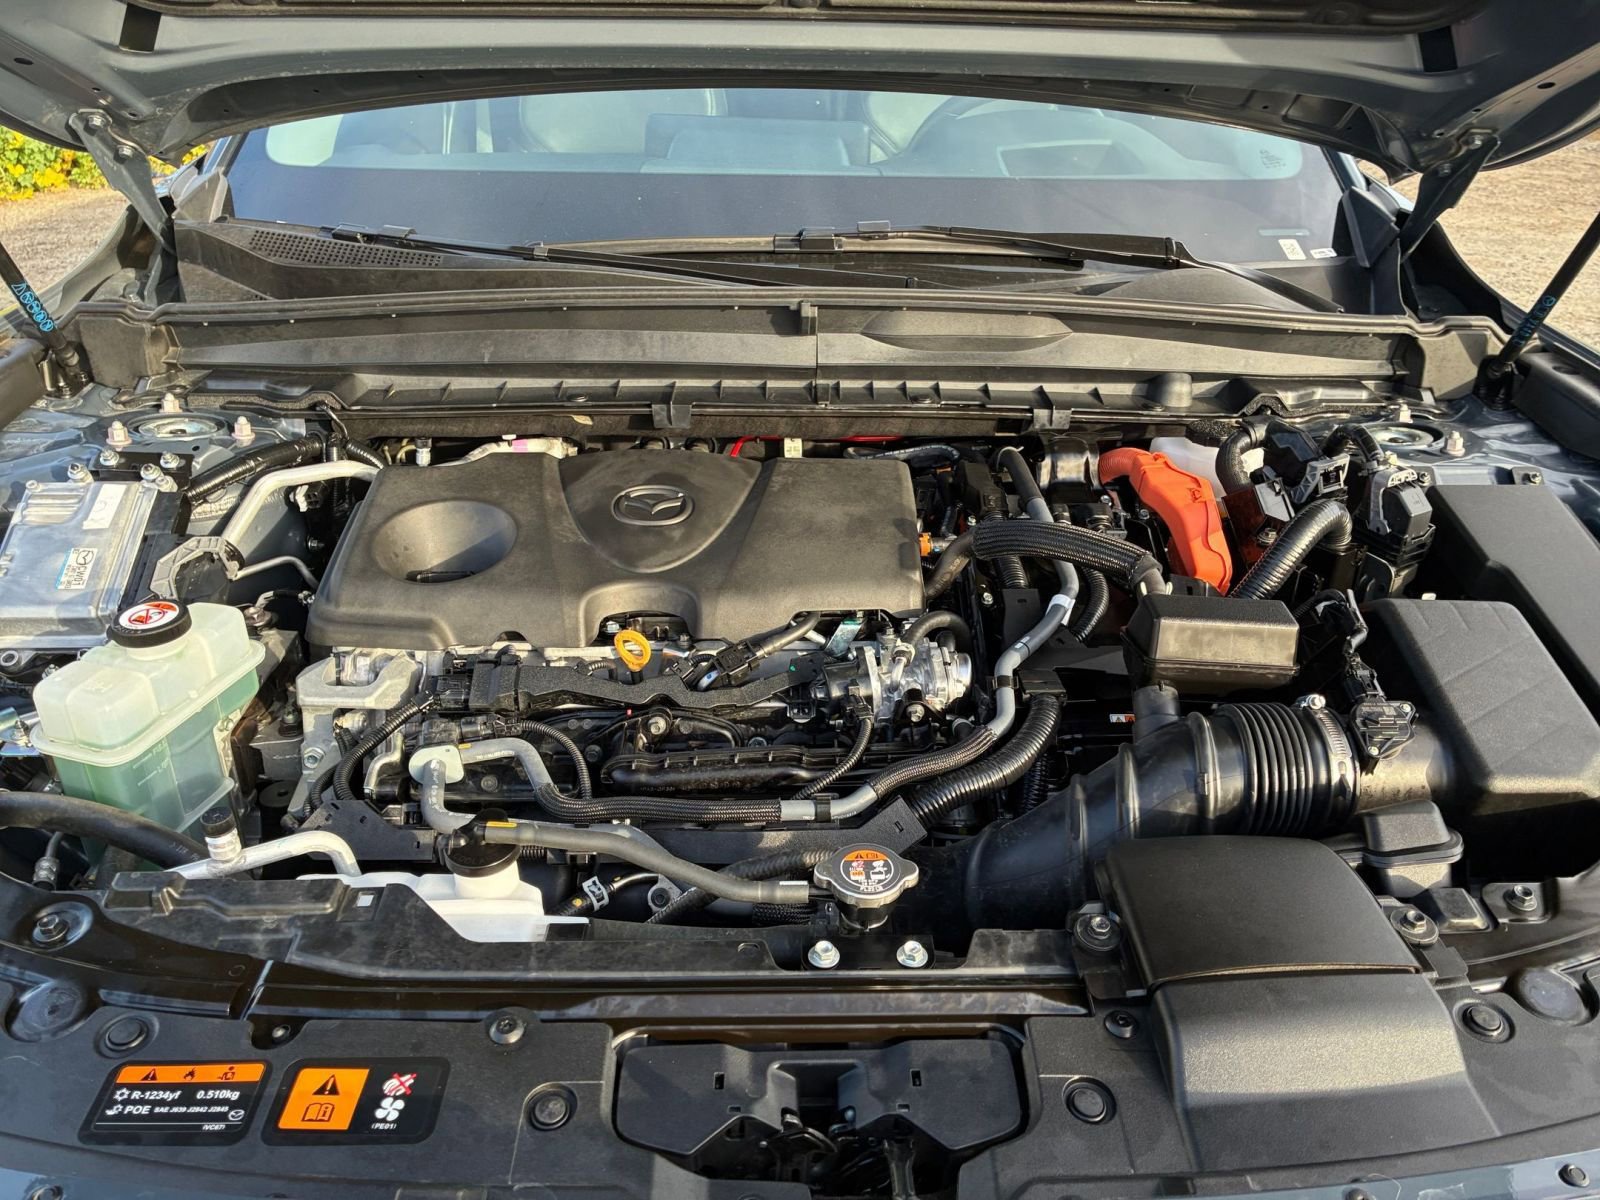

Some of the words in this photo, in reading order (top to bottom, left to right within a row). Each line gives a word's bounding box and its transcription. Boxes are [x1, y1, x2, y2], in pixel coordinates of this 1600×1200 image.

[130, 1090, 182, 1101] R-1234yf
[196, 1089, 240, 1101] 0.510kg
[123, 1105, 152, 1115] POE
